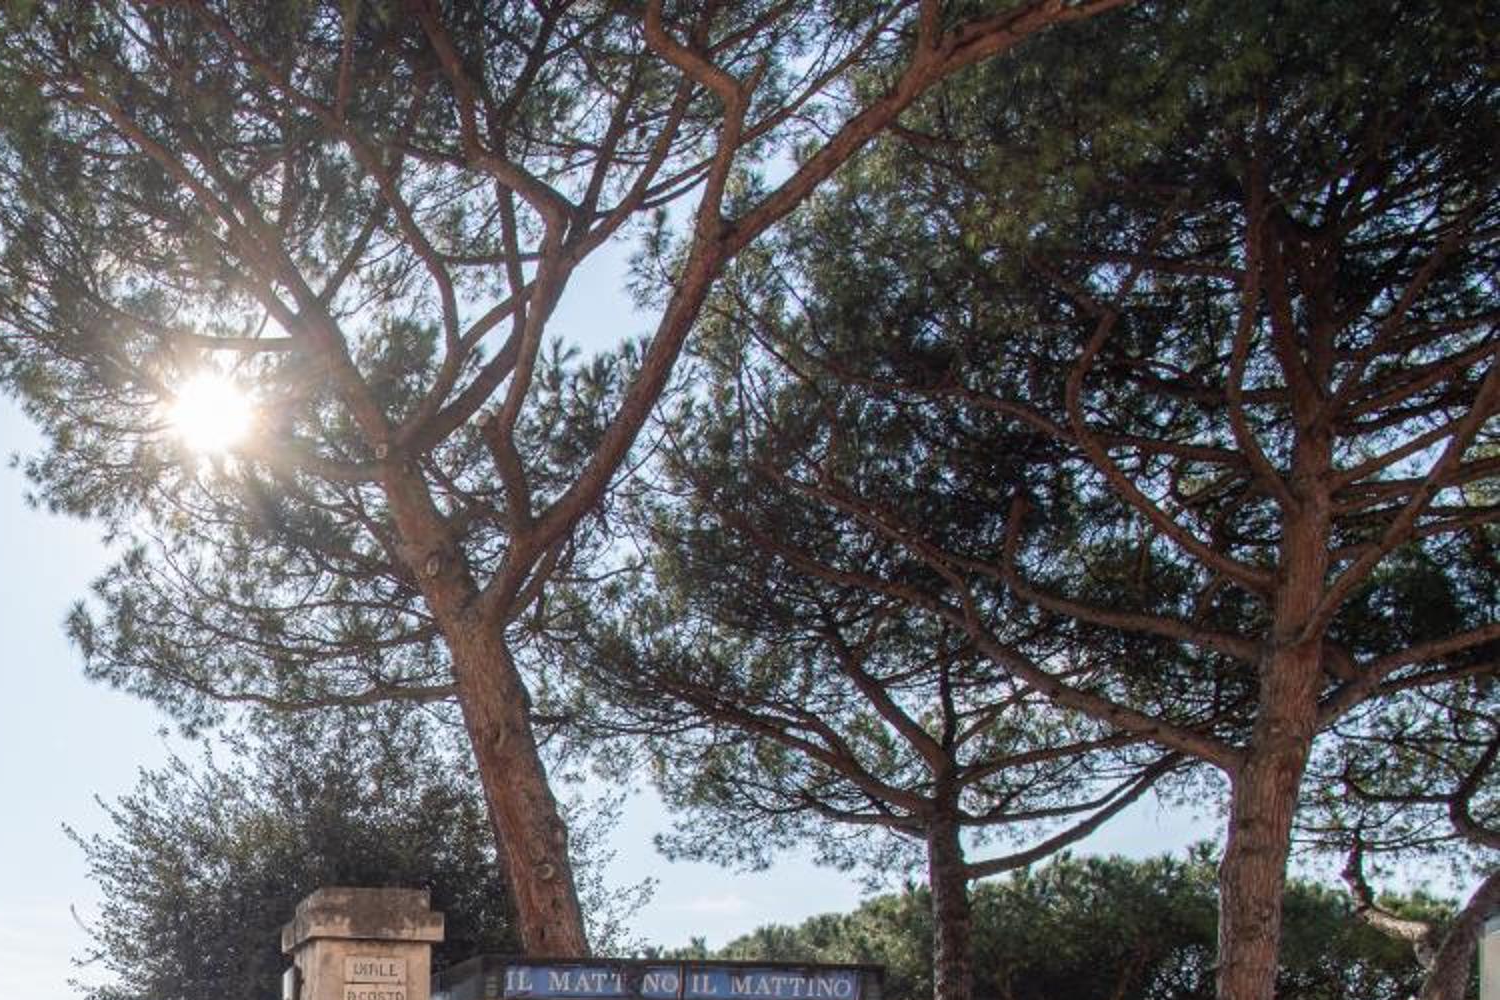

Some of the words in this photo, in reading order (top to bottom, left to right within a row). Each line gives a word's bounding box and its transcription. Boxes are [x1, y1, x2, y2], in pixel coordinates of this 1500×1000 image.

[353, 961, 399, 977] VIALE
[505, 969, 533, 992] IL
[691, 974, 717, 994] IL
[731, 974, 852, 998] MATTINO
